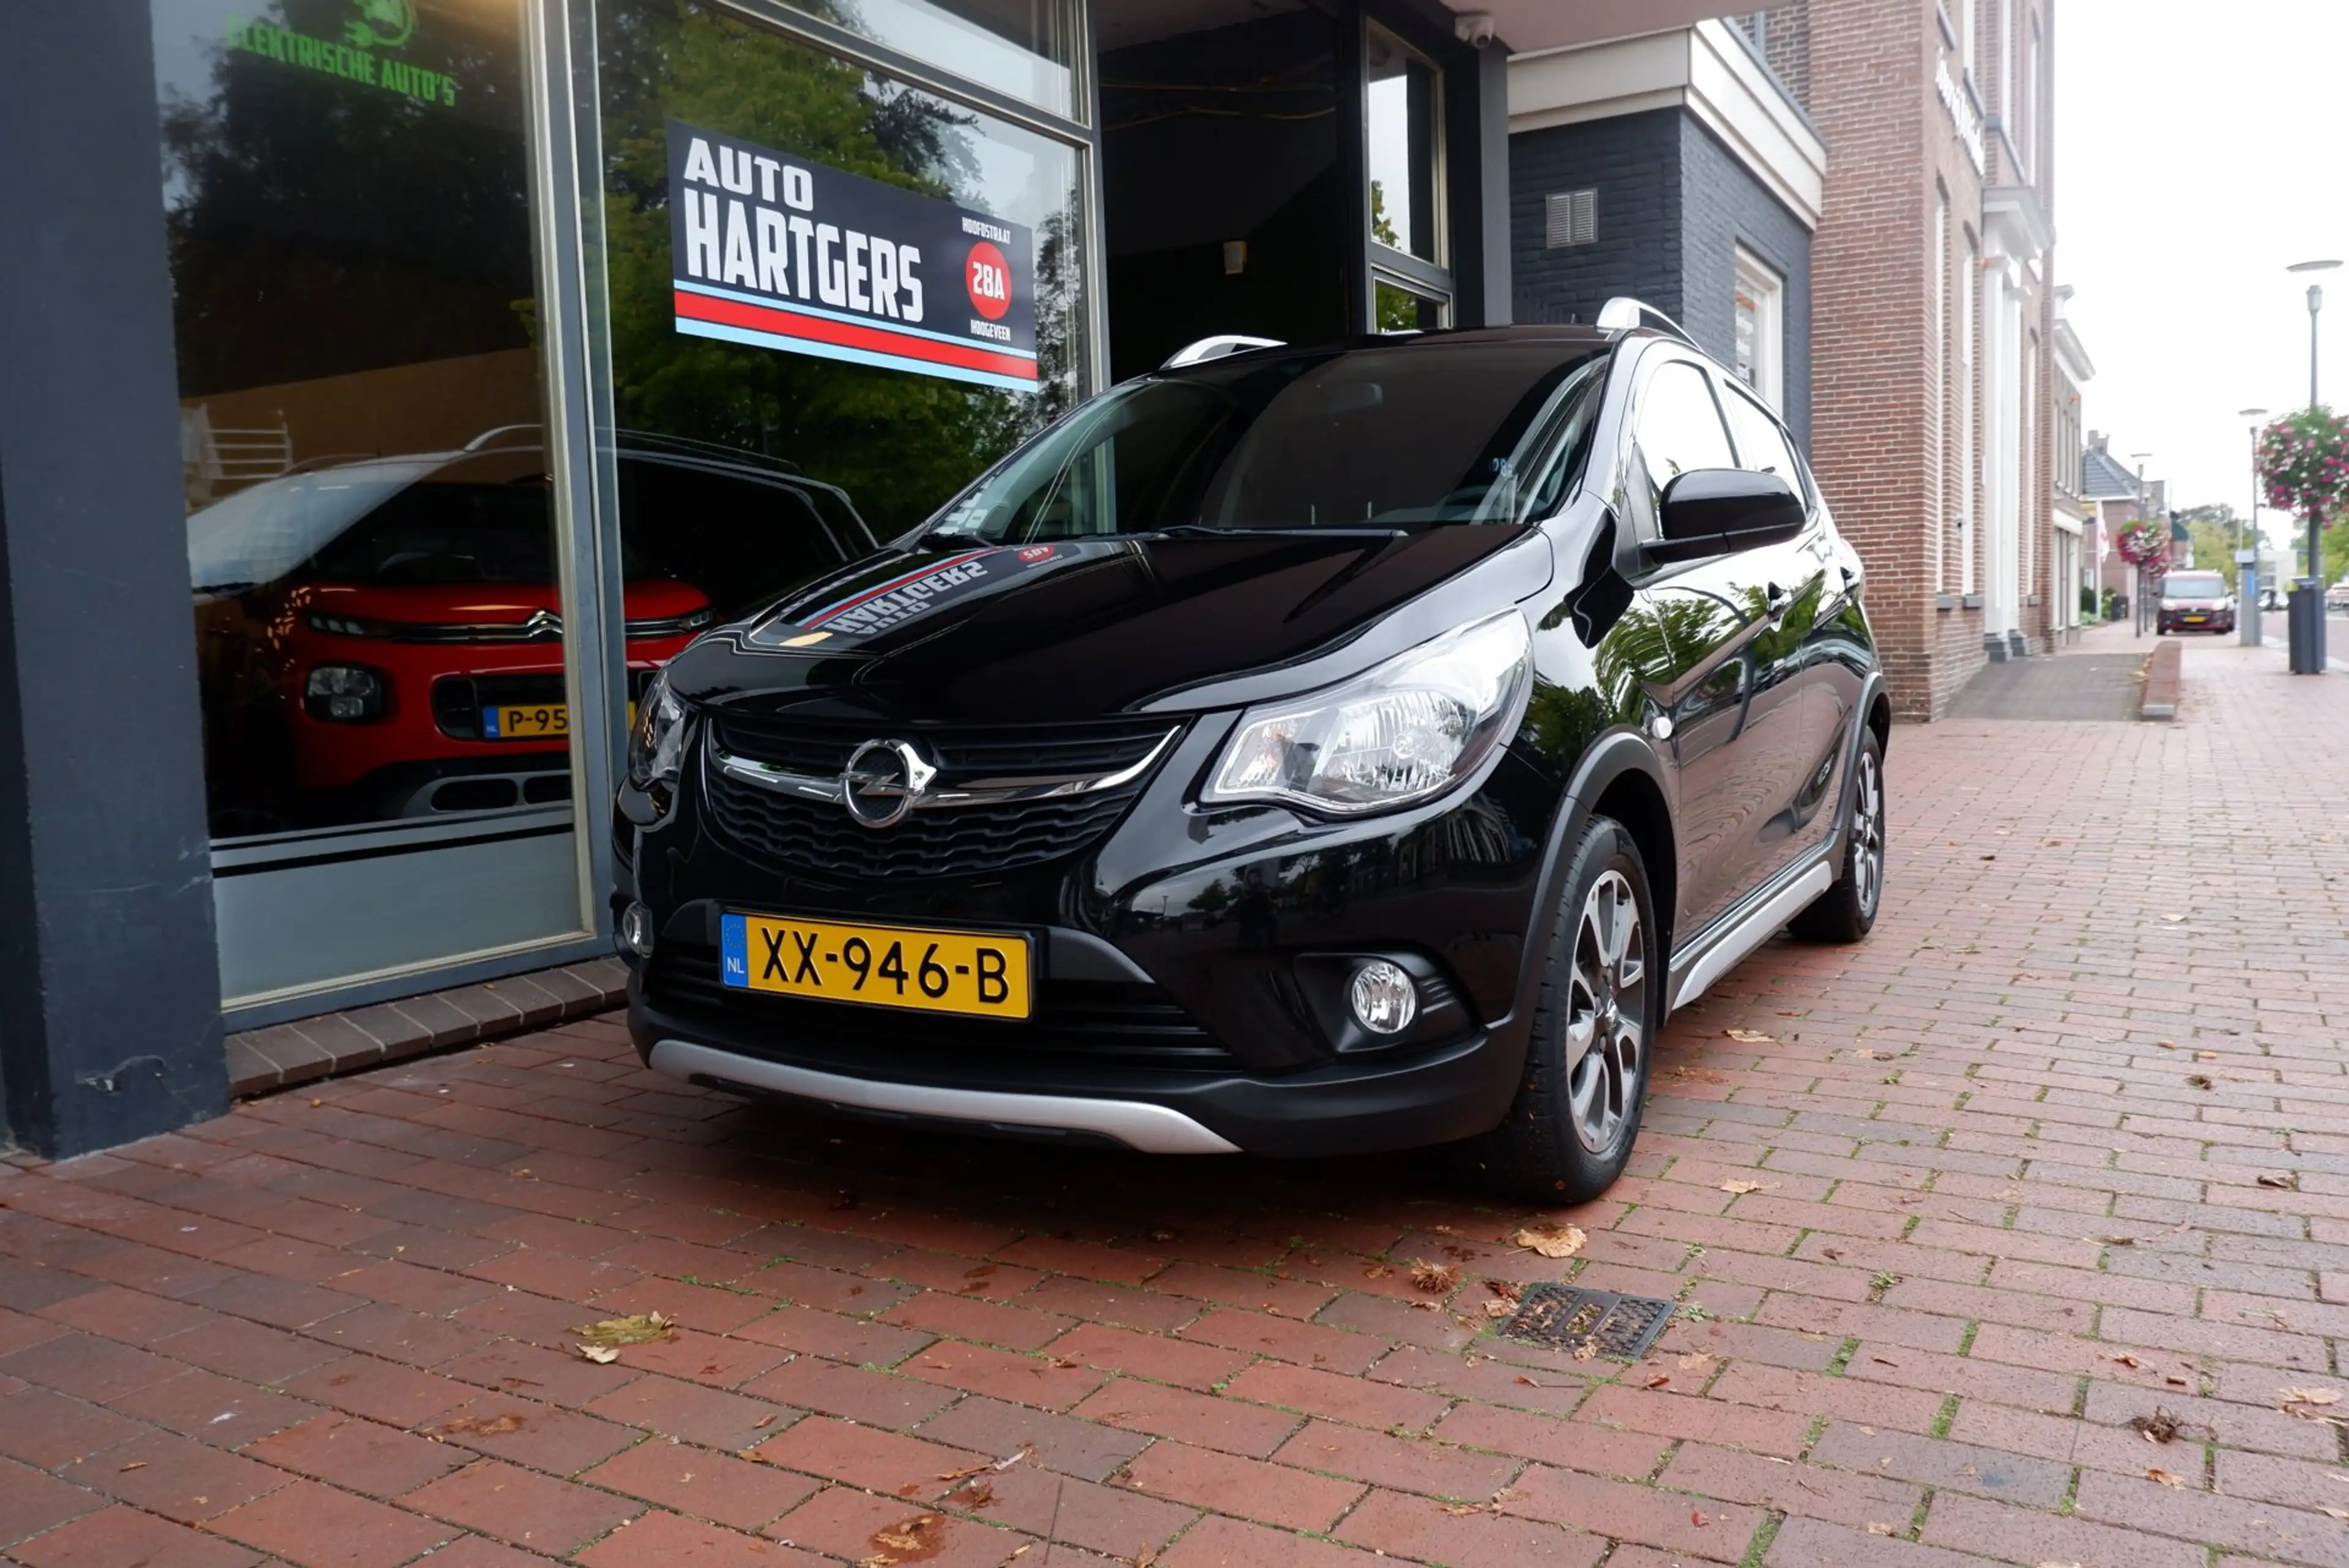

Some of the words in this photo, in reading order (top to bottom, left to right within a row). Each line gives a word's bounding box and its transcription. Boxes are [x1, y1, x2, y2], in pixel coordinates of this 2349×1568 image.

[382, 59, 455, 106] AUTO'S
[683, 137, 814, 212] AUTO
[683, 188, 924, 322] HARTGERS
[973, 261, 1006, 300] 28A
[970, 319, 1011, 341] HOOGEVEEN
[727, 957, 744, 975] NL
[762, 927, 1009, 1004] XX-946-B
